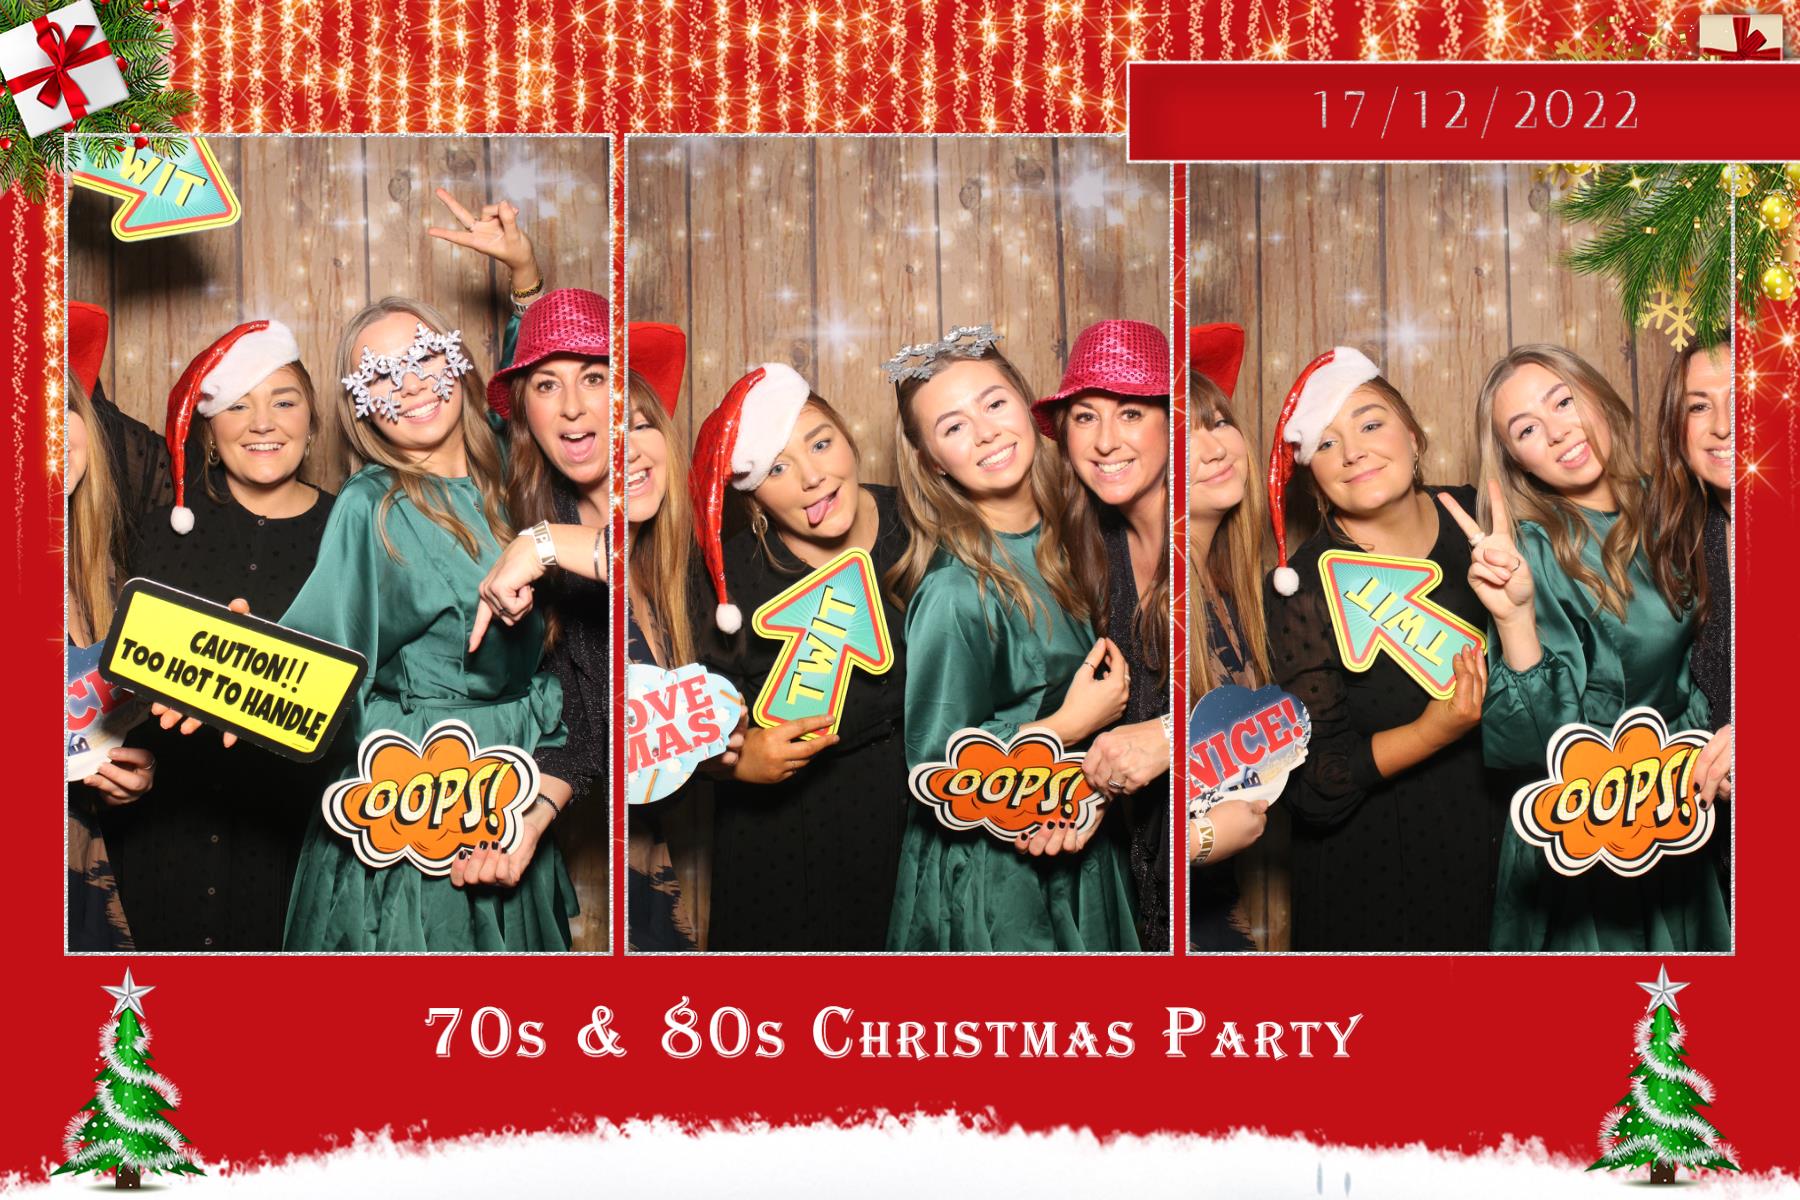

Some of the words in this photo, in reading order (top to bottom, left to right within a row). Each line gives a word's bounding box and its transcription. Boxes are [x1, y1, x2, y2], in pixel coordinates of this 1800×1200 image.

[95, 145, 207, 207] WIT
[786, 585, 857, 705] TWIT
[1344, 577, 1449, 667] TWIT
[120, 637, 165, 673] TOO
[164, 656, 214, 693] HOT
[212, 673, 242, 705] TO
[239, 686, 328, 742] HANDLE
[190, 630, 309, 694] CAUTION!!
[359, 762, 516, 835] OOPS!
[943, 766, 1084, 820] OOPS!
[1551, 747, 1702, 828] OOPS!
